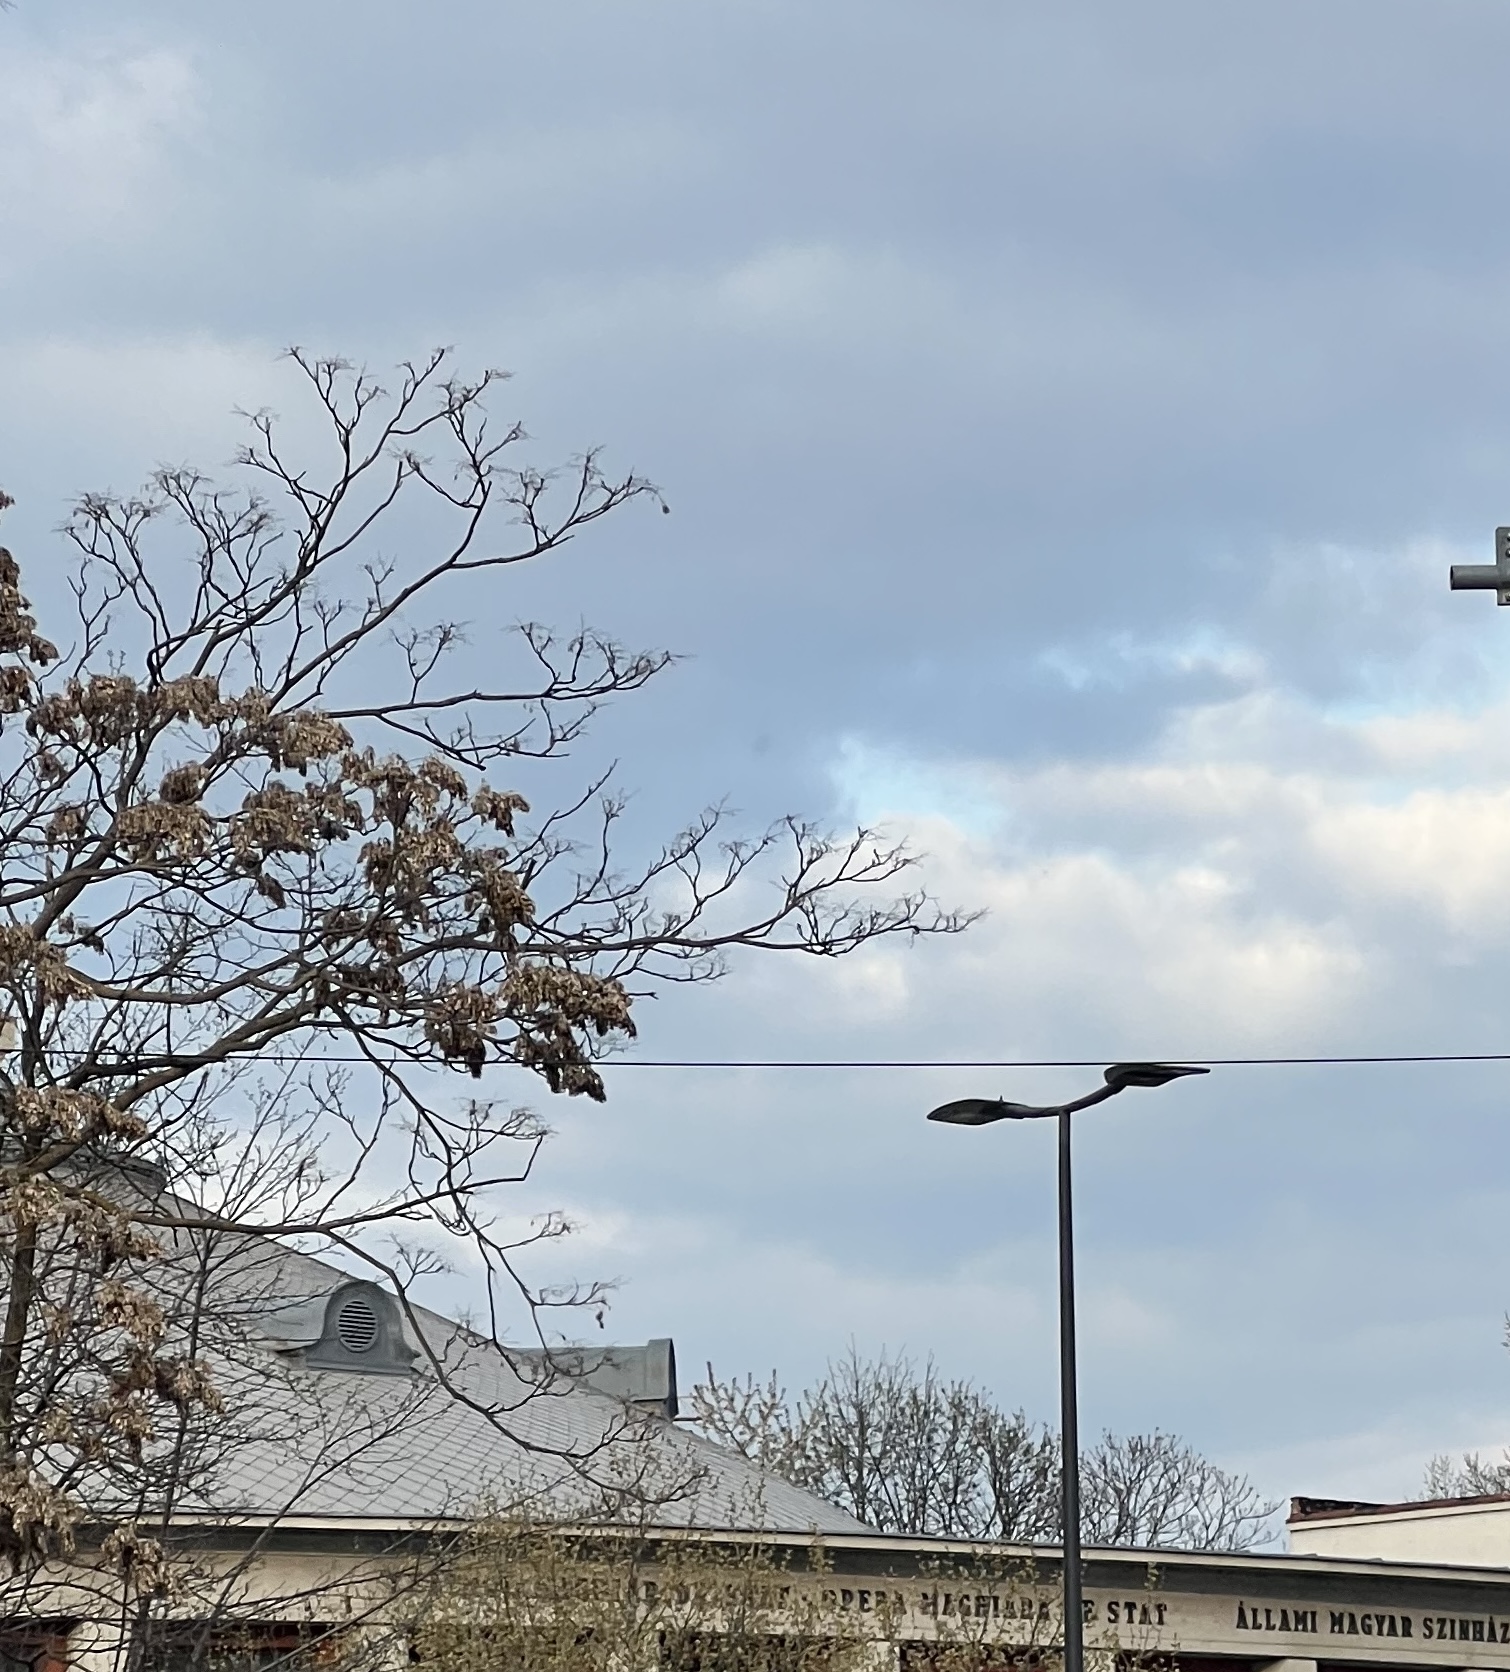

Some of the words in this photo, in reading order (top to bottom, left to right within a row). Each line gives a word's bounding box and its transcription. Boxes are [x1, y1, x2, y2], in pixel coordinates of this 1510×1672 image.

[1107, 1601, 1168, 1625] STAT
[1236, 1600, 1318, 1633] ÁLLAMI
[1329, 1610, 1413, 1638] MAGYAR
